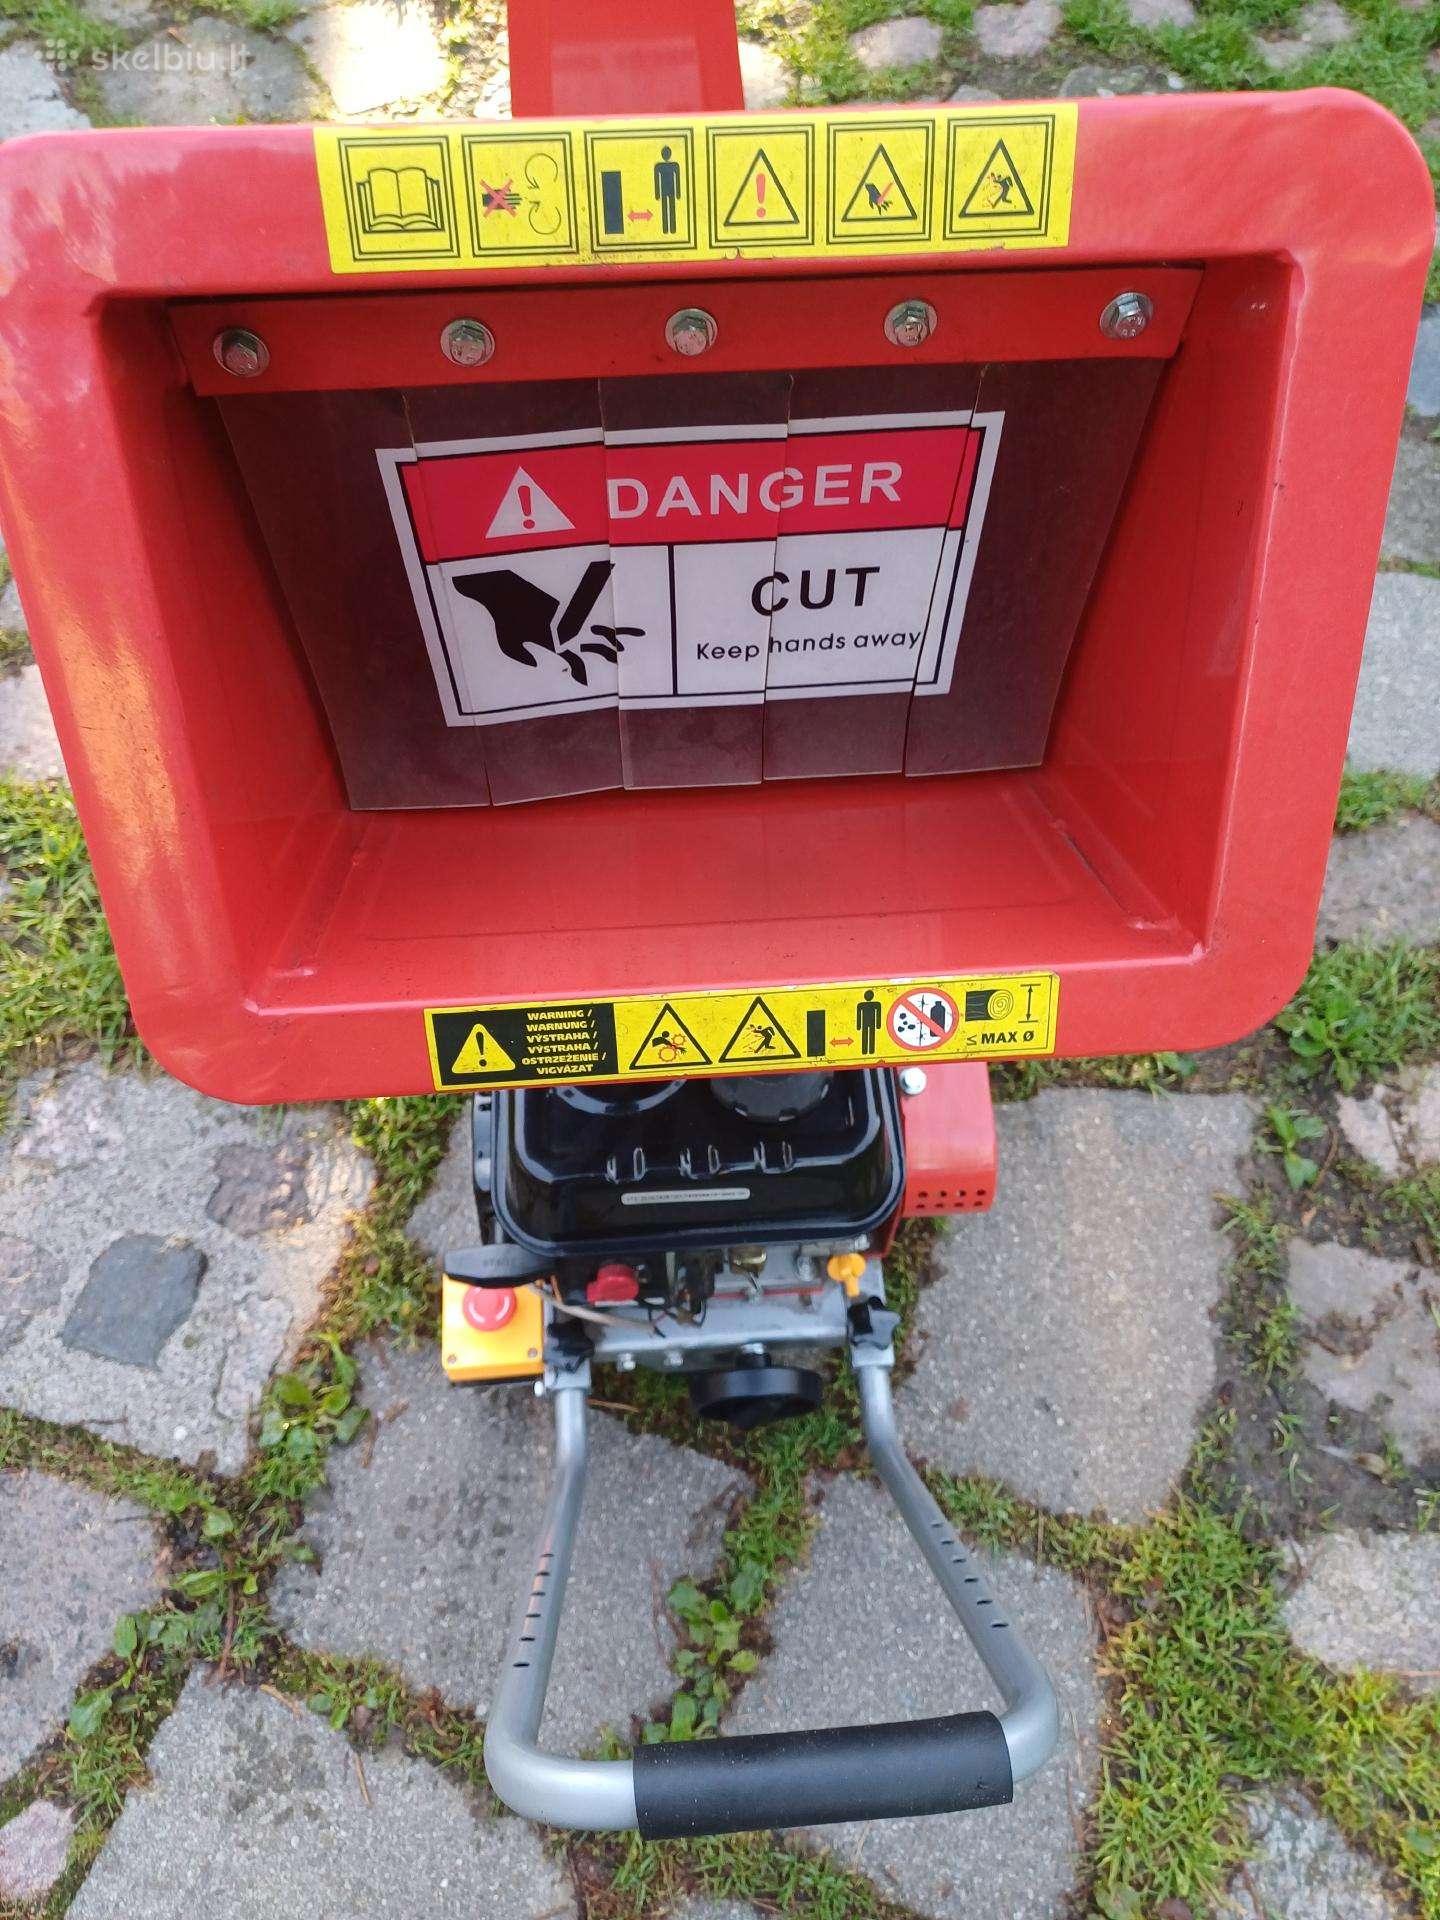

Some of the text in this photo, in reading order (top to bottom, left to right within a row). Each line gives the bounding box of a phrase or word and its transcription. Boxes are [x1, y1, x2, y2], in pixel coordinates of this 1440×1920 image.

[606, 461, 903, 520] DANGER
[750, 565, 881, 617] CUT
[696, 630, 922, 662] Keep hands away
[526, 1020, 588, 1032] WARNUNG
[527, 1010, 584, 1020] WARNING
[981, 1031, 1018, 1045] MAX
